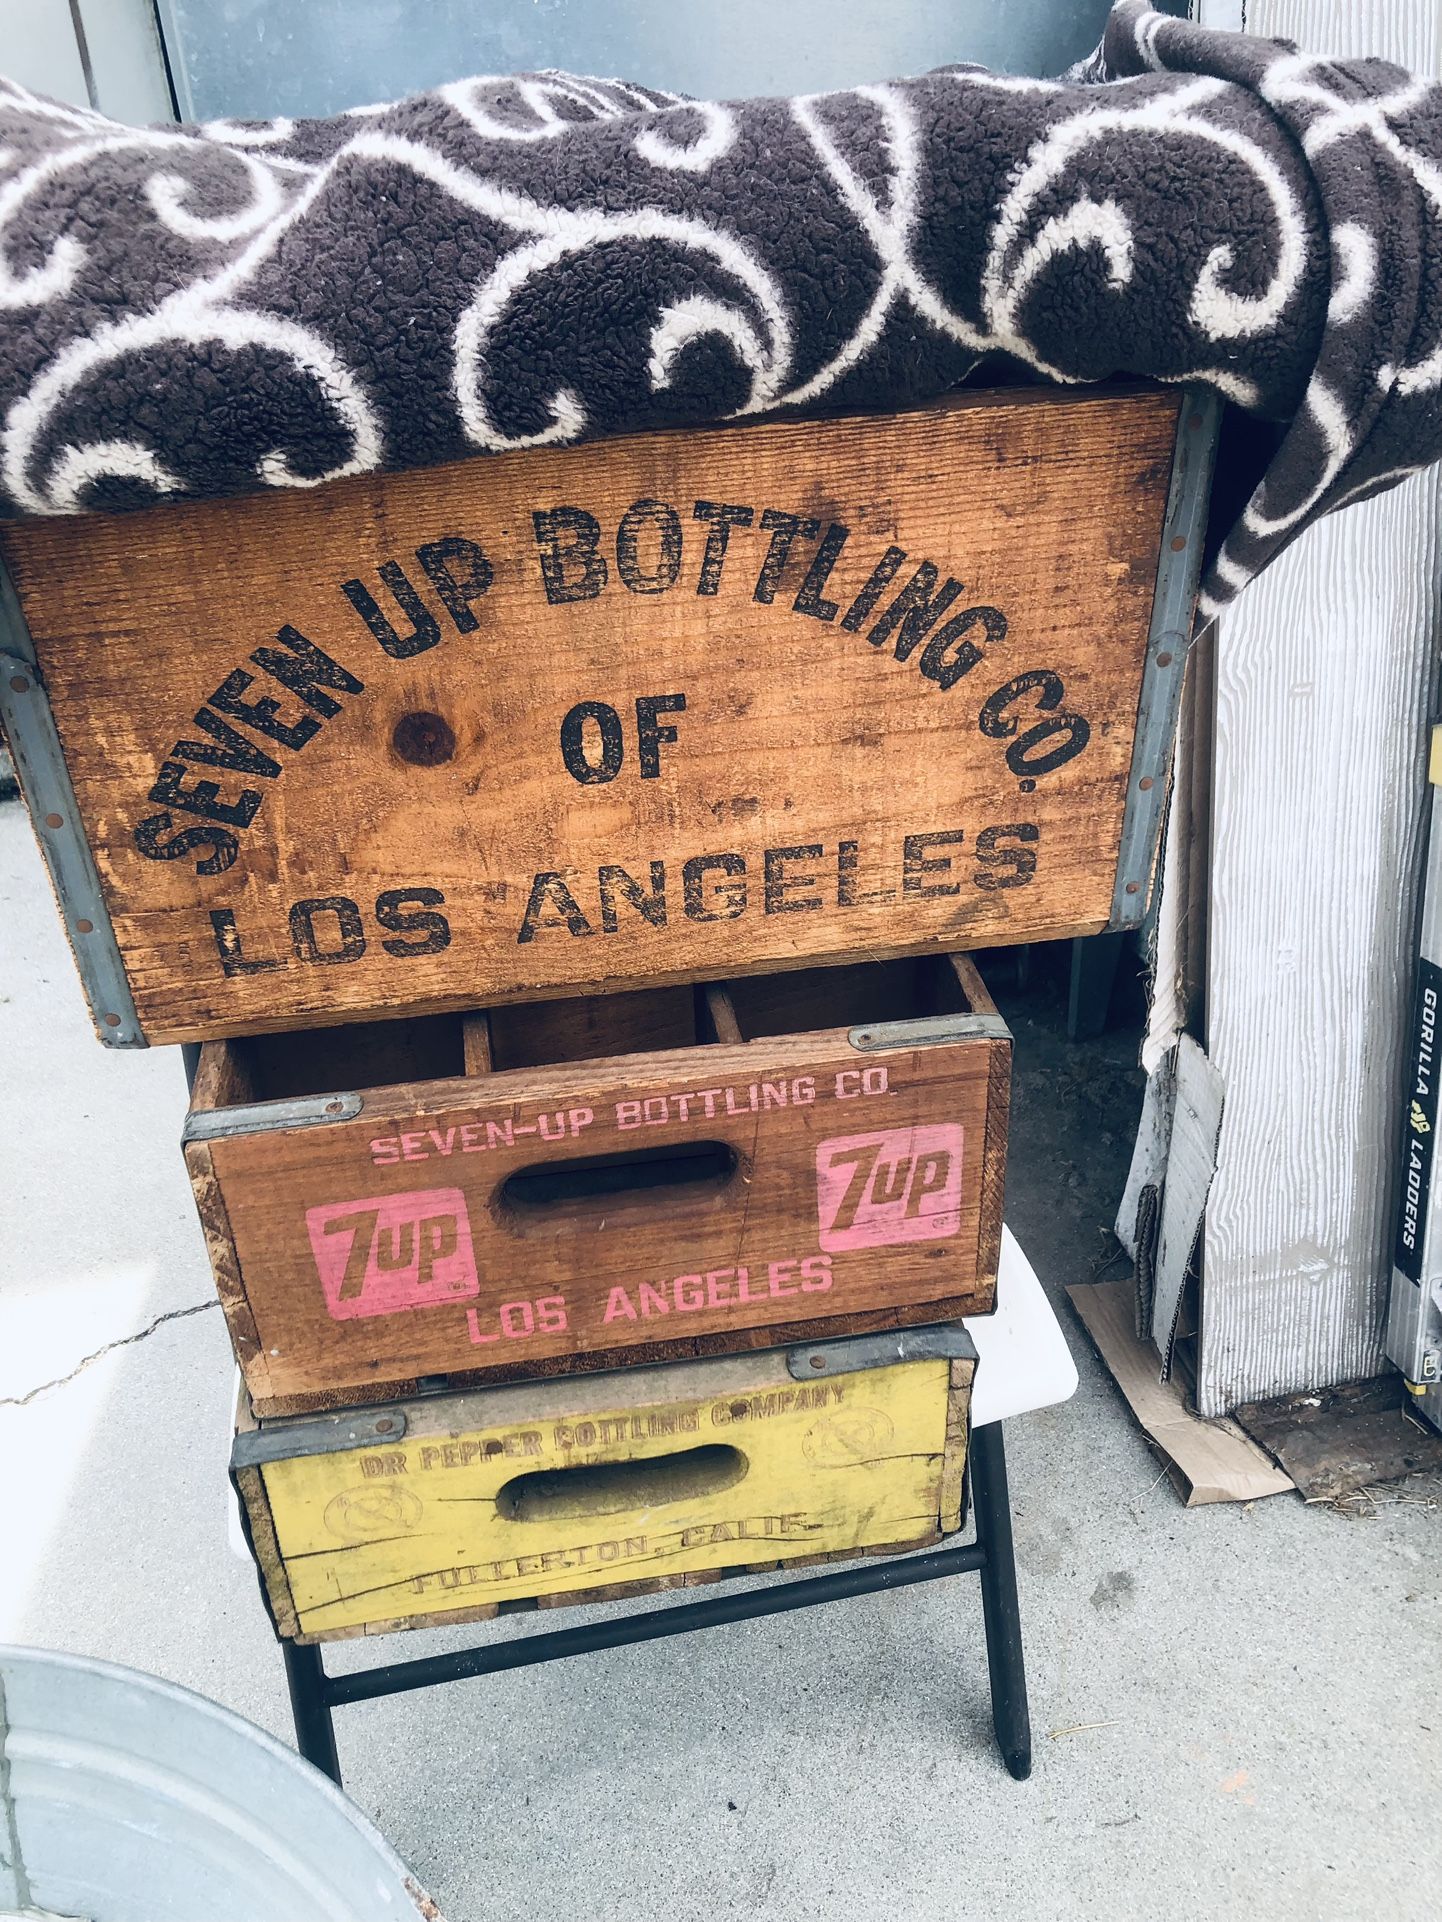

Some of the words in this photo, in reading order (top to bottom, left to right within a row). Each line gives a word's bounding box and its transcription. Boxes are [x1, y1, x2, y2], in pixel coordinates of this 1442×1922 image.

[134, 624, 364, 876] SEVEN
[340, 537, 494, 659] UP
[532, 499, 1008, 690] BOTTLING
[561, 692, 686, 785] OF
[209, 886, 452, 978] LOS
[517, 822, 1040, 944] ANGELES
[1414, 987, 1437, 1096] GORILLA
[369, 1106, 594, 1165] SEVEN-UP
[615, 1077, 816, 1131] BOTTLING
[1402, 1138, 1425, 1250] LADDERS
[466, 1295, 568, 1345] LOS
[601, 1254, 834, 1326] ANGELES
[359, 1450, 409, 1480] DR
[419, 1429, 543, 1471] PEPPER
[553, 1408, 700, 1451] BOTTLING
[711, 1383, 846, 1427] COMPANY
